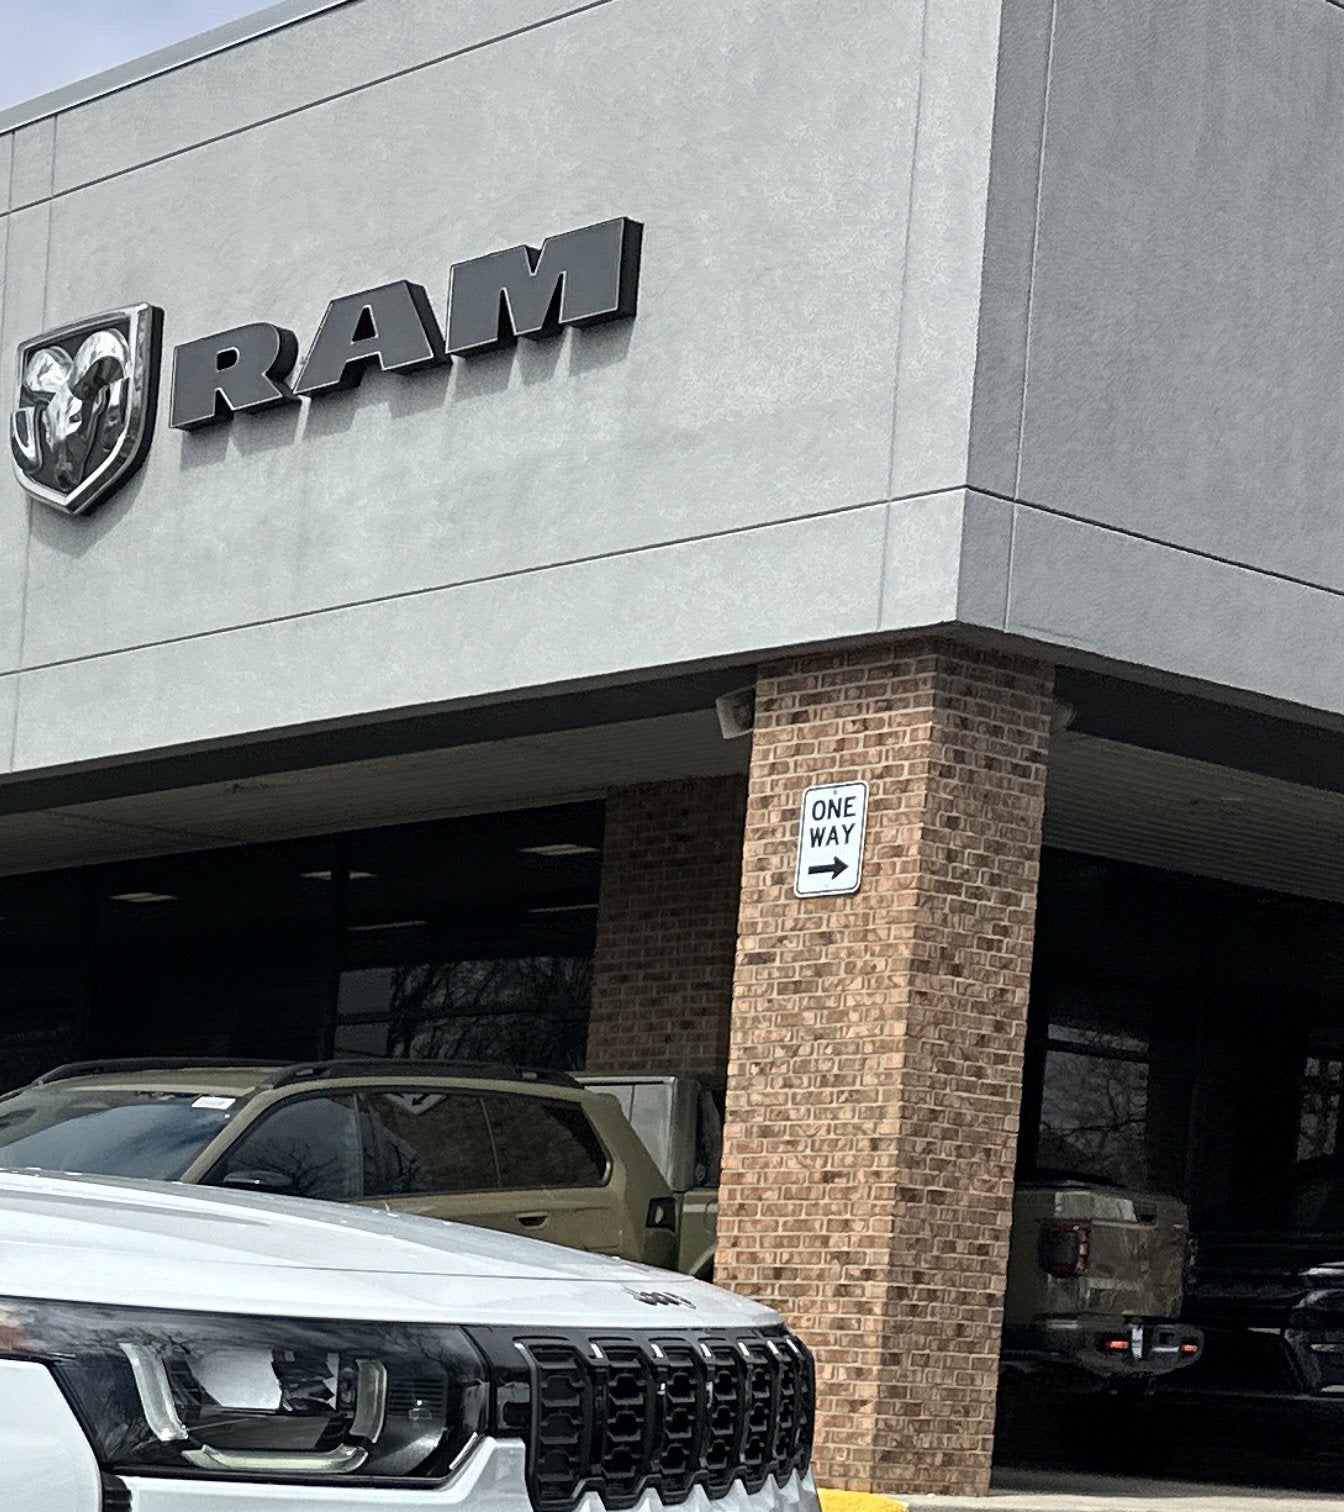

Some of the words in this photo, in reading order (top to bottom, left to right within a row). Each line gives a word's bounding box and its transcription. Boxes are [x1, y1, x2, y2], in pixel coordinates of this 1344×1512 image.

[170, 216, 644, 433] RAM
[812, 796, 856, 821] ONE
[810, 823, 855, 848] WAY
